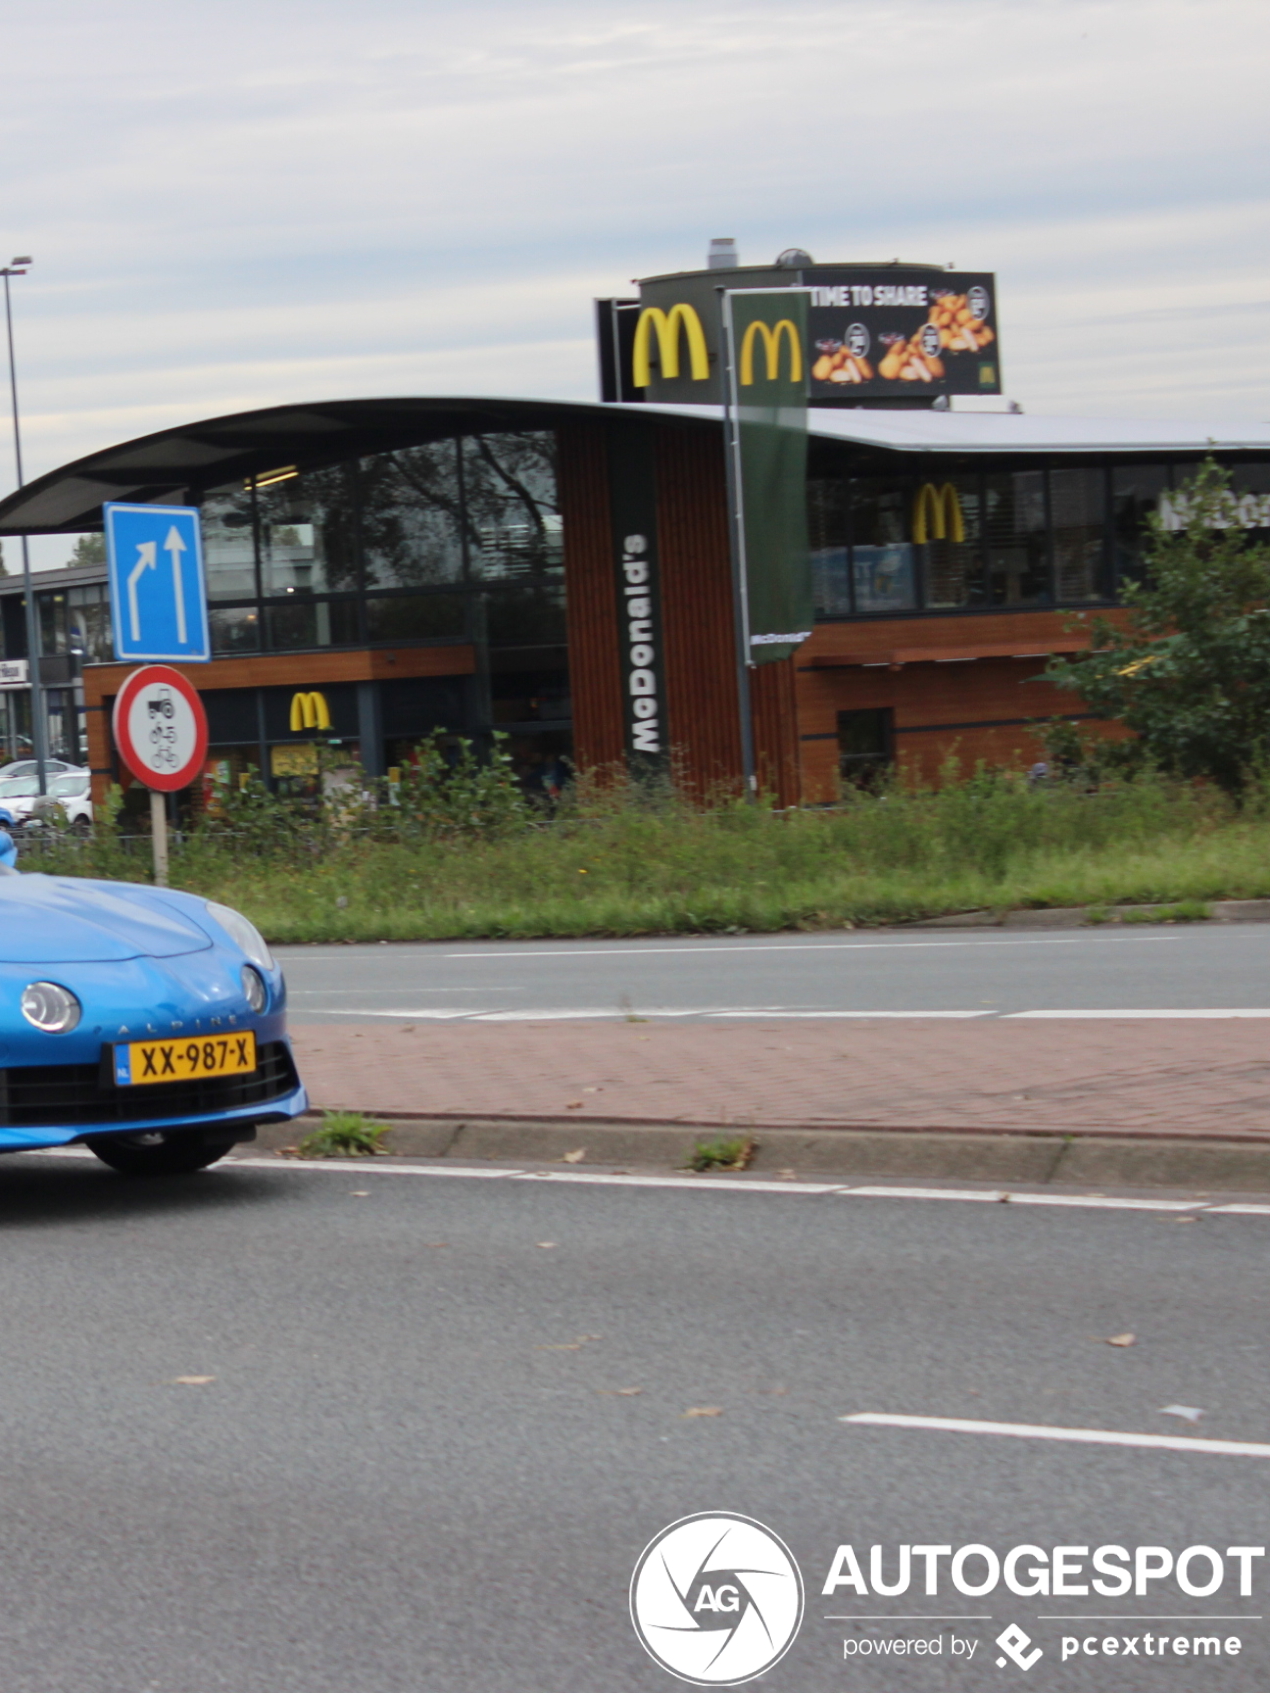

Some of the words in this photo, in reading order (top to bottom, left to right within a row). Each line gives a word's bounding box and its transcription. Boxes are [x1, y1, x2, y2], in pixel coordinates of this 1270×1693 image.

[810, 286, 849, 306] TIME
[850, 286, 873, 306] TO
[874, 286, 928, 306] SHARE
[622, 534, 660, 753] McDonald's
[118, 1015, 237, 1034] ALPINE
[141, 1038, 248, 1077] XX-987-X
[117, 1068, 129, 1078] NL
